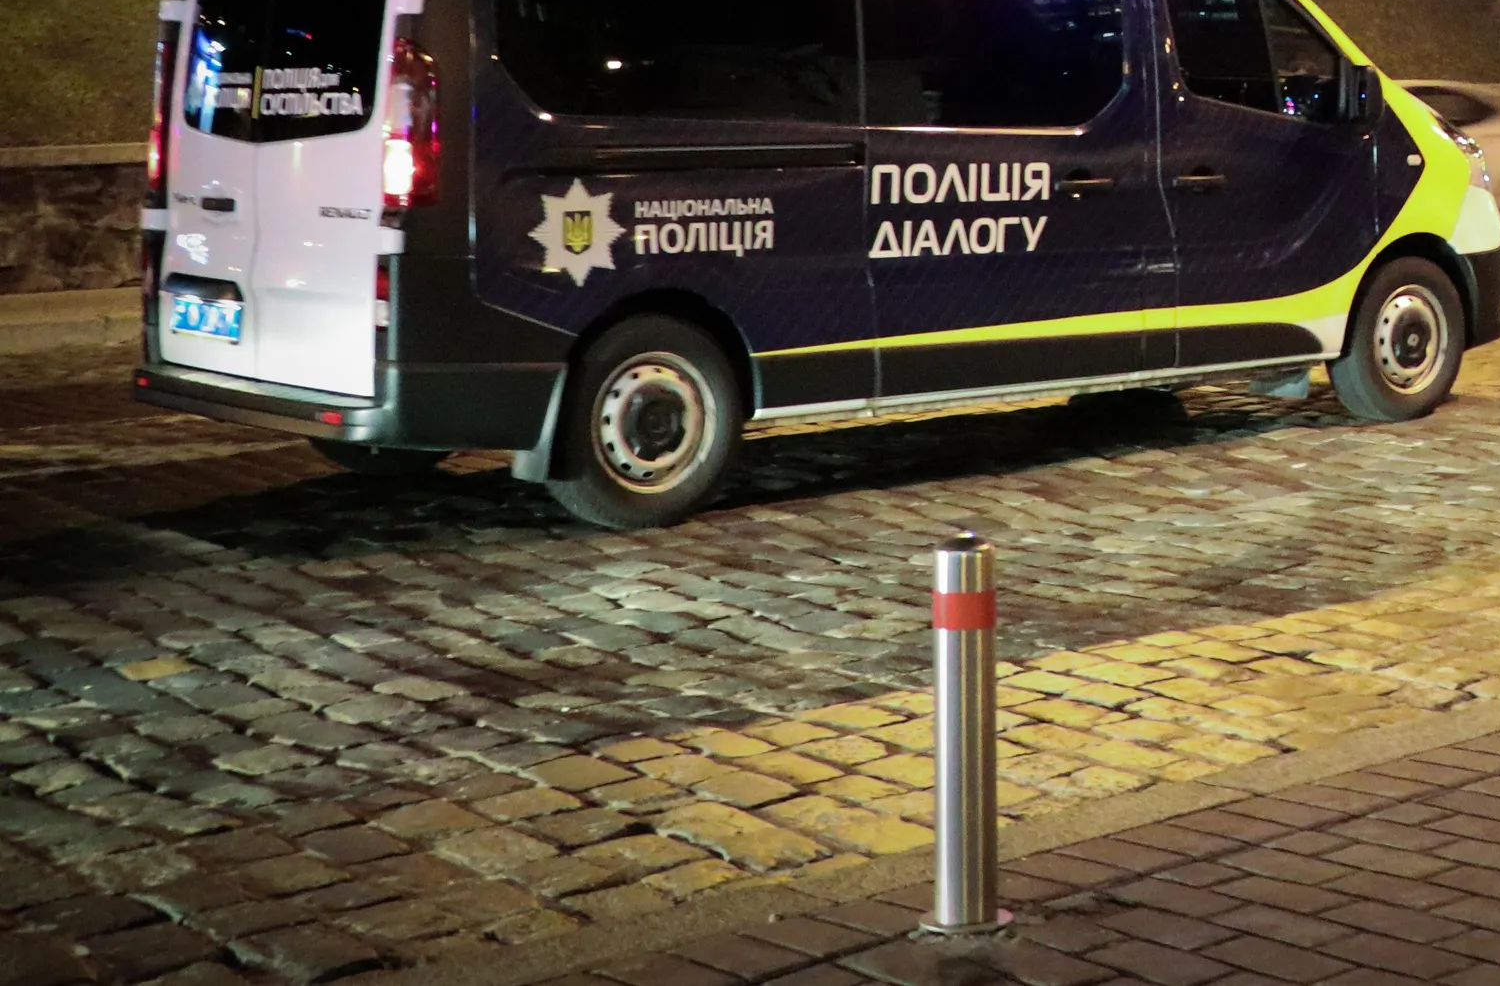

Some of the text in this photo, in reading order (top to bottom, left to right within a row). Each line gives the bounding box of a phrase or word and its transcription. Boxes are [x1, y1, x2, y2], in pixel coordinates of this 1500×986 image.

[871, 162, 1050, 204] ПОЛІЦІЯ
[635, 198, 774, 220] НАЦІОНАЛЬНА
[635, 222, 774, 256] ПОЛІЦІЯ
[869, 216, 1047, 258] ДІАЛОГУ
